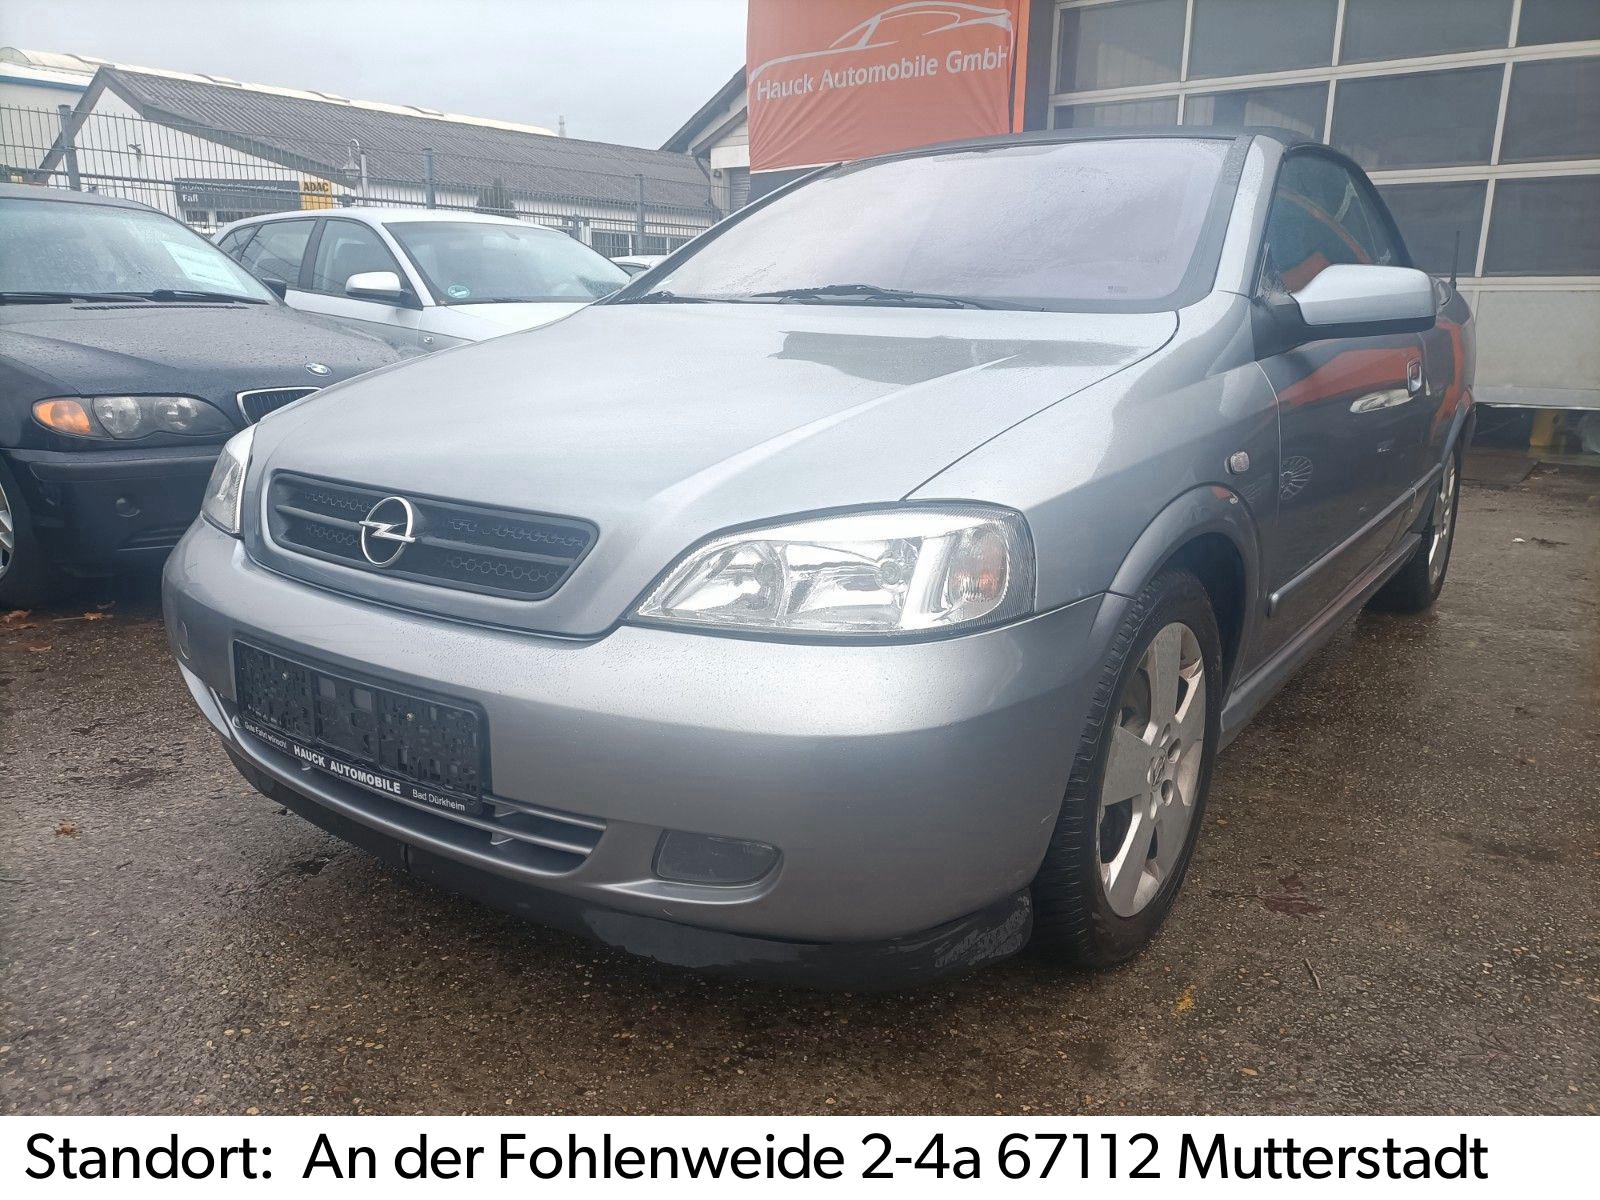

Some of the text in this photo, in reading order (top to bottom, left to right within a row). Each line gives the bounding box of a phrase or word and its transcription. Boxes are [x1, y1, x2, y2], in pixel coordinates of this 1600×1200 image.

[756, 73, 814, 101] Hauck
[819, 54, 939, 91] Automobile
[303, 181, 330, 193] ADAC
[293, 744, 326, 768] HAUCK
[330, 760, 402, 795] AUTOMOBILE
[412, 788, 427, 801] Bad
[428, 793, 466, 812] Dürkheim
